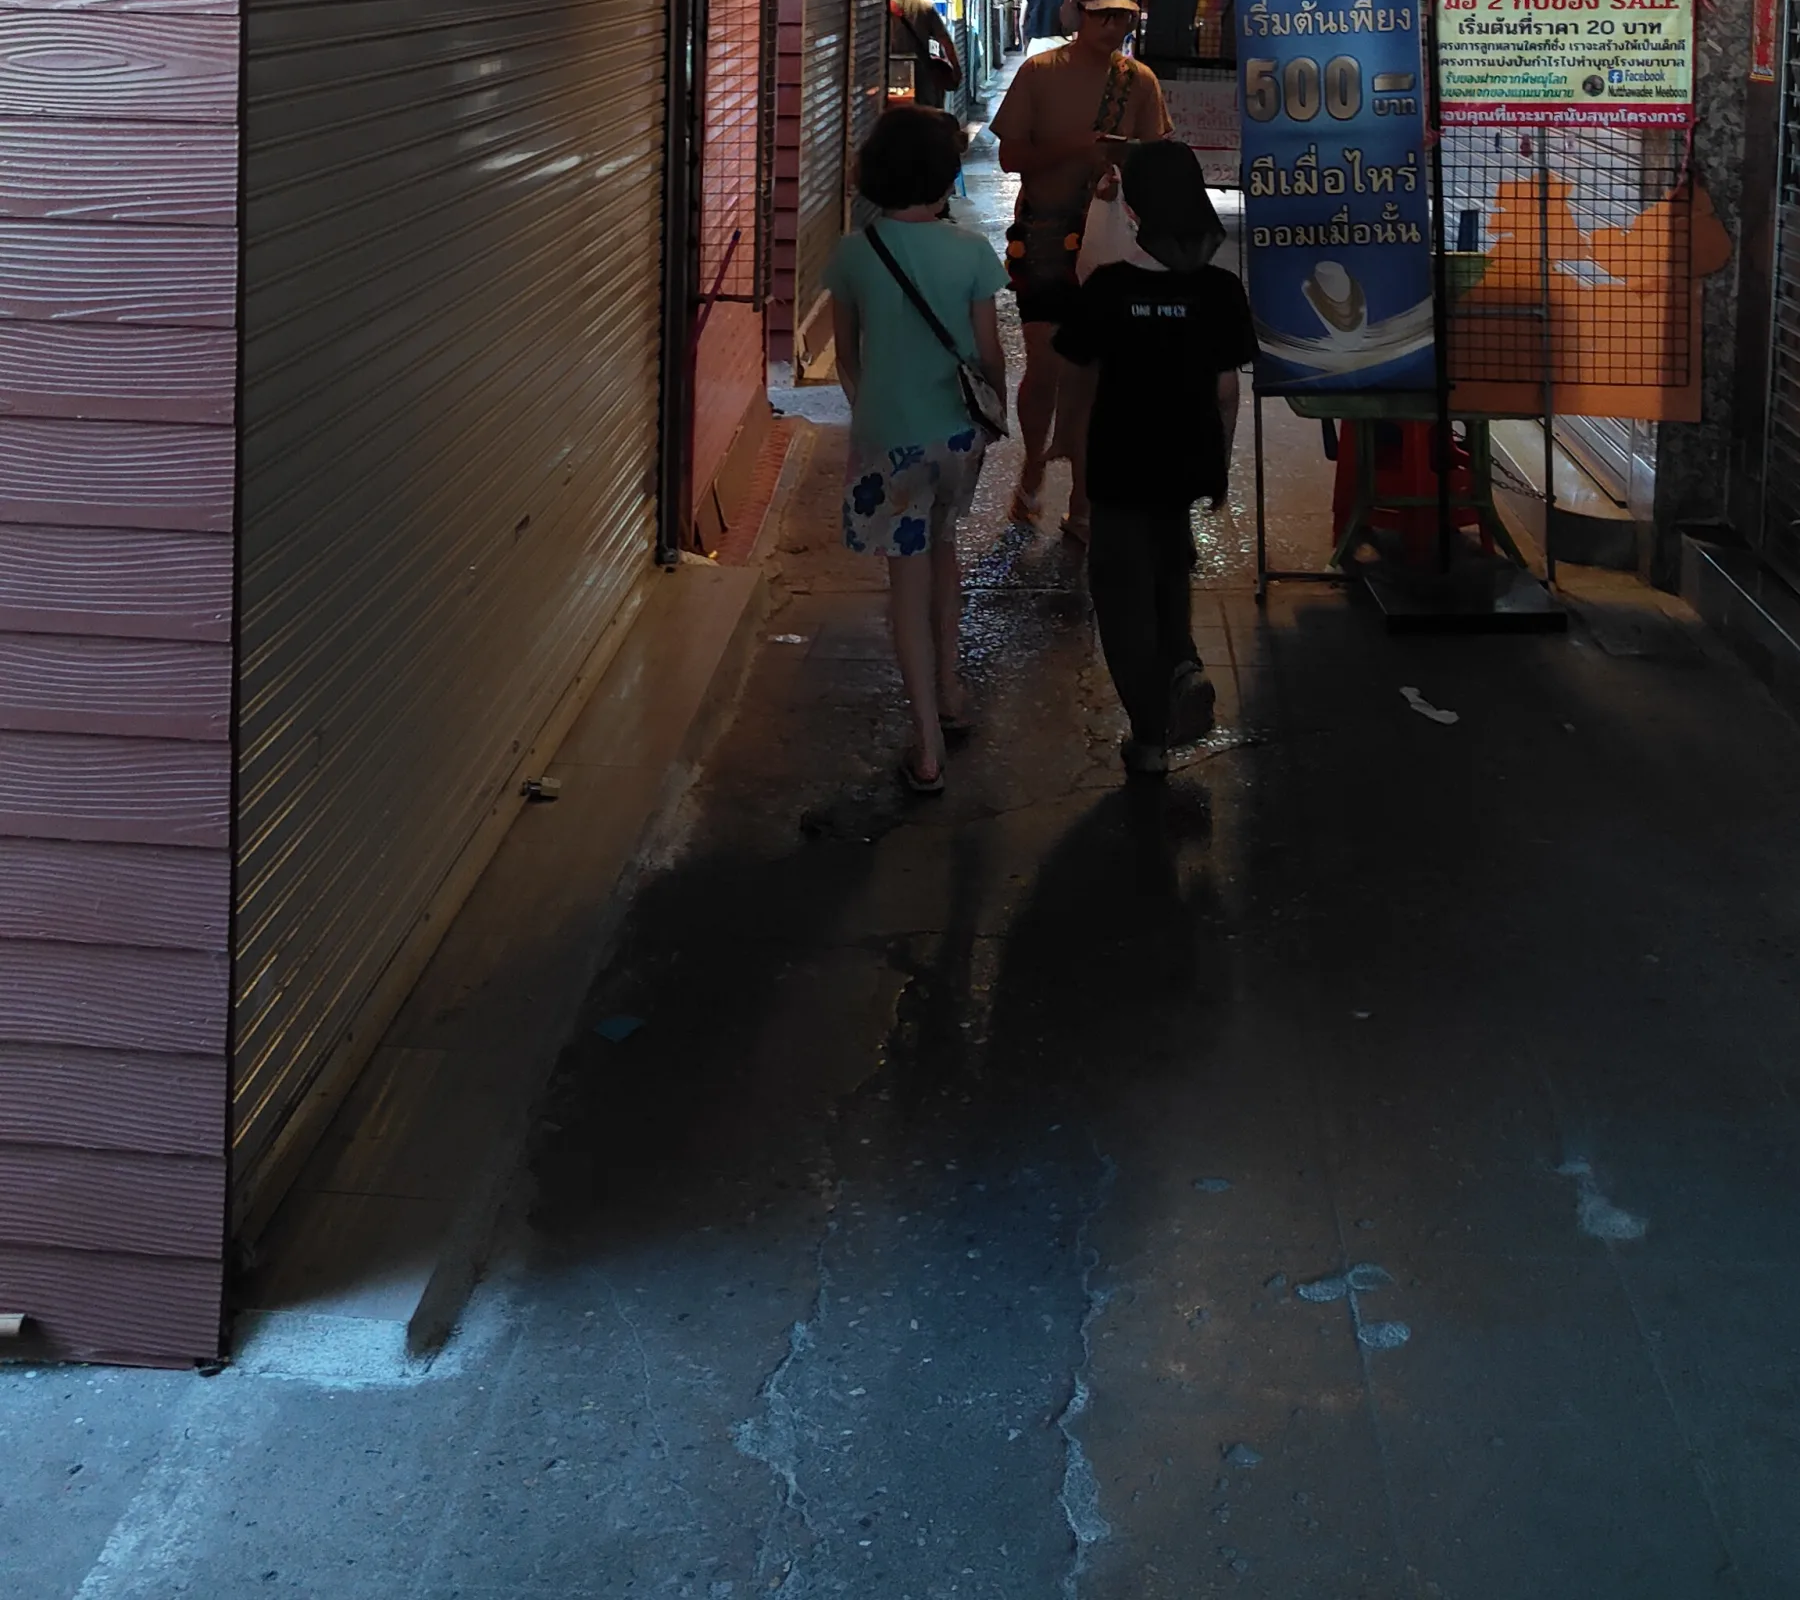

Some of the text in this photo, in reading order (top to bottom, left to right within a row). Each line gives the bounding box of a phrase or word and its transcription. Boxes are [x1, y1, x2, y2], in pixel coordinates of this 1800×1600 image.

[1459, 12, 1662, 35] เริ่มต้นที่ราคา 20 บาท
[1440, 55, 1685, 70] ครงการแบ่งปันกำไรไปทำบุญโรงพยาบาล
[1624, 69, 1666, 82] Facebook
[1245, 54, 1362, 122] 500
[1372, 97, 1417, 116] บาท
[1440, 104, 1687, 126] อบคุณที่แวะมาสนับสนุนโครงการ
[1250, 144, 1419, 197] มีเมื่อไหร่
[1252, 202, 1422, 248] ออมเมื่อนั้น
